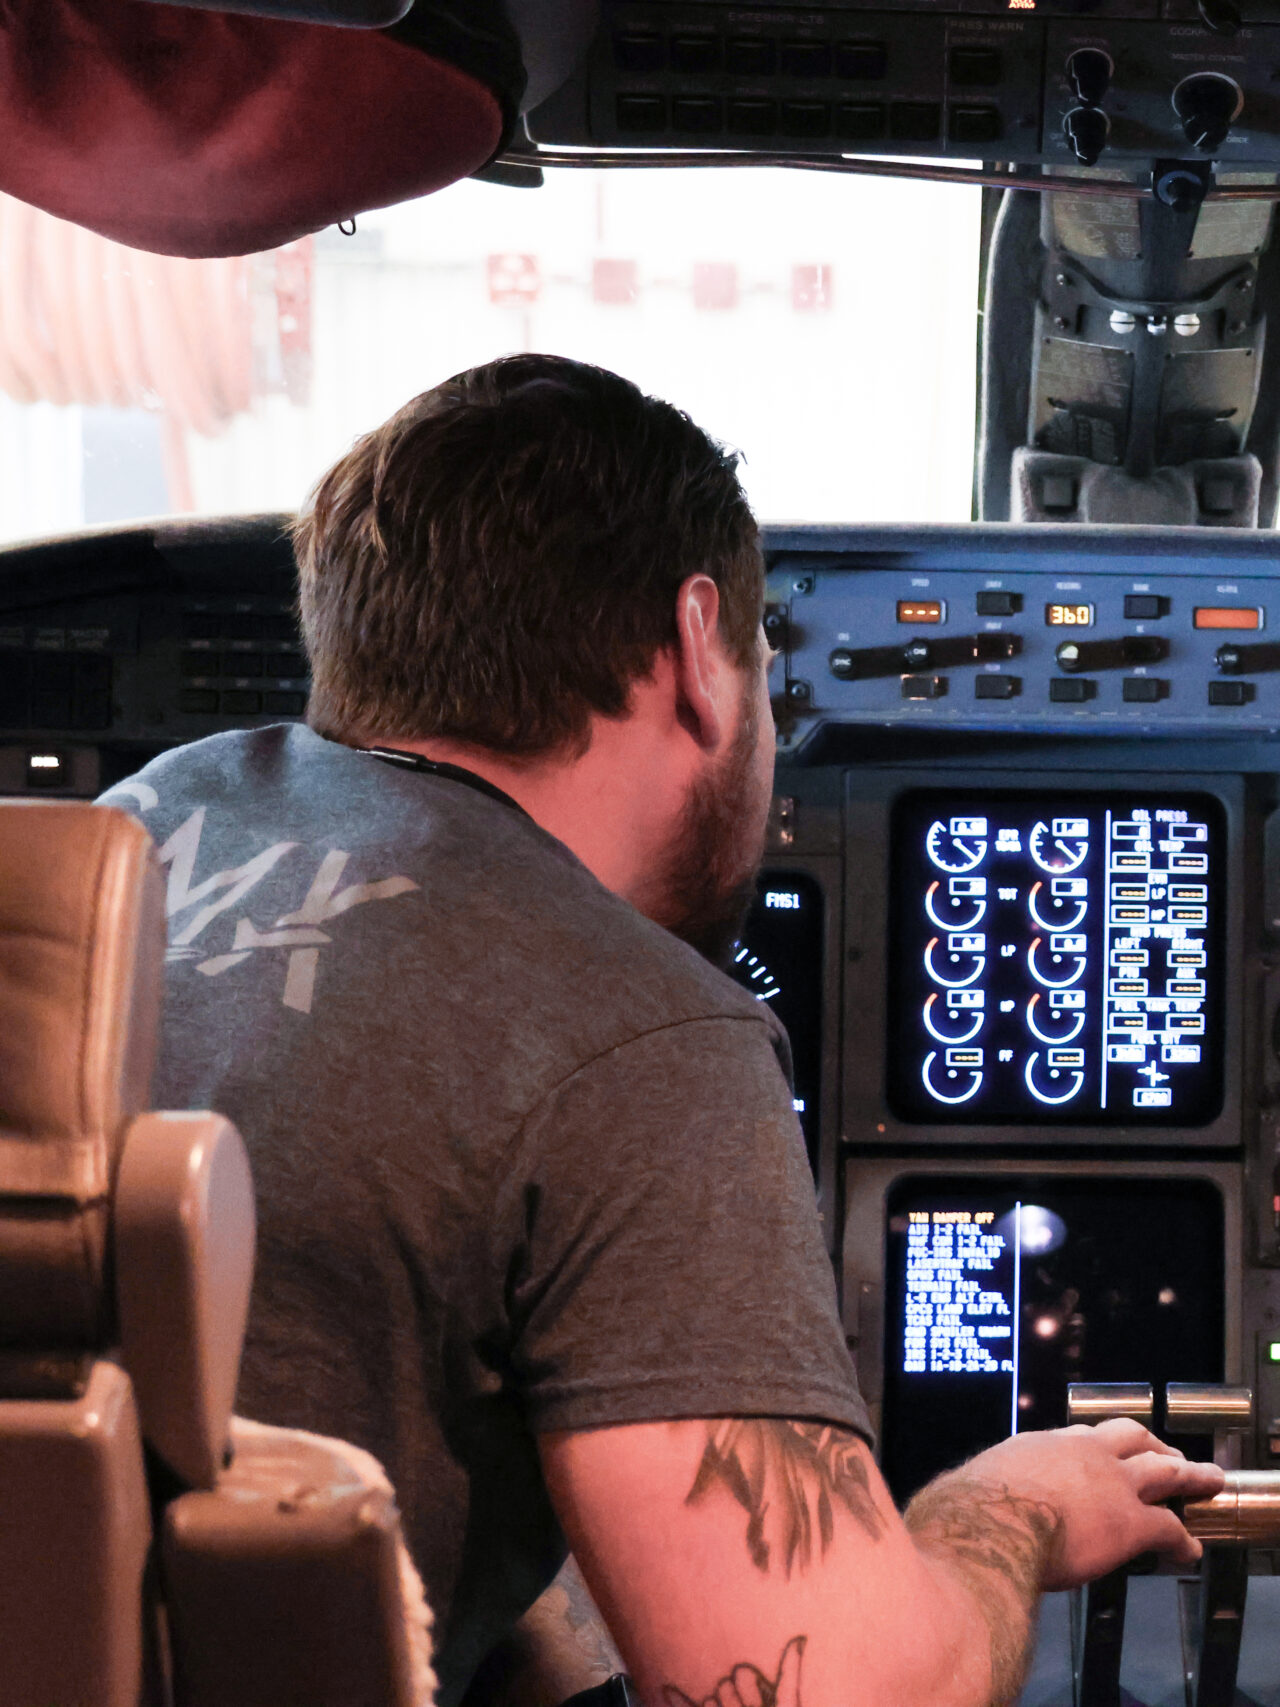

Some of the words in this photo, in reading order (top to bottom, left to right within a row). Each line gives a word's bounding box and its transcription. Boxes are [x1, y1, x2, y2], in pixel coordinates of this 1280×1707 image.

[1151, 887, 1166, 900] LP
[765, 892, 800, 909] FMS1
[1114, 937, 1141, 949] LEFT
[1171, 938, 1204, 950] RIGHT
[1001, 944, 1016, 956] LP
[934, 1223, 954, 1235] 1-2
[956, 1223, 983, 1236] FAIL
[958, 1235, 977, 1247] 1-2
[980, 1235, 1006, 1247] FAIL
[967, 1258, 994, 1270] FAIL
[937, 1269, 964, 1281] FAIL
[955, 1280, 981, 1292] FAIL
[955, 1292, 976, 1304] ALT
[905, 1314, 933, 1326] TCAS
[936, 1315, 963, 1326] FAIL
[930, 1326, 975, 1338] SPOILER
[930, 1337, 951, 1349] SYS
[954, 1337, 980, 1349] FAIL
[966, 1349, 992, 1361] FAIL
